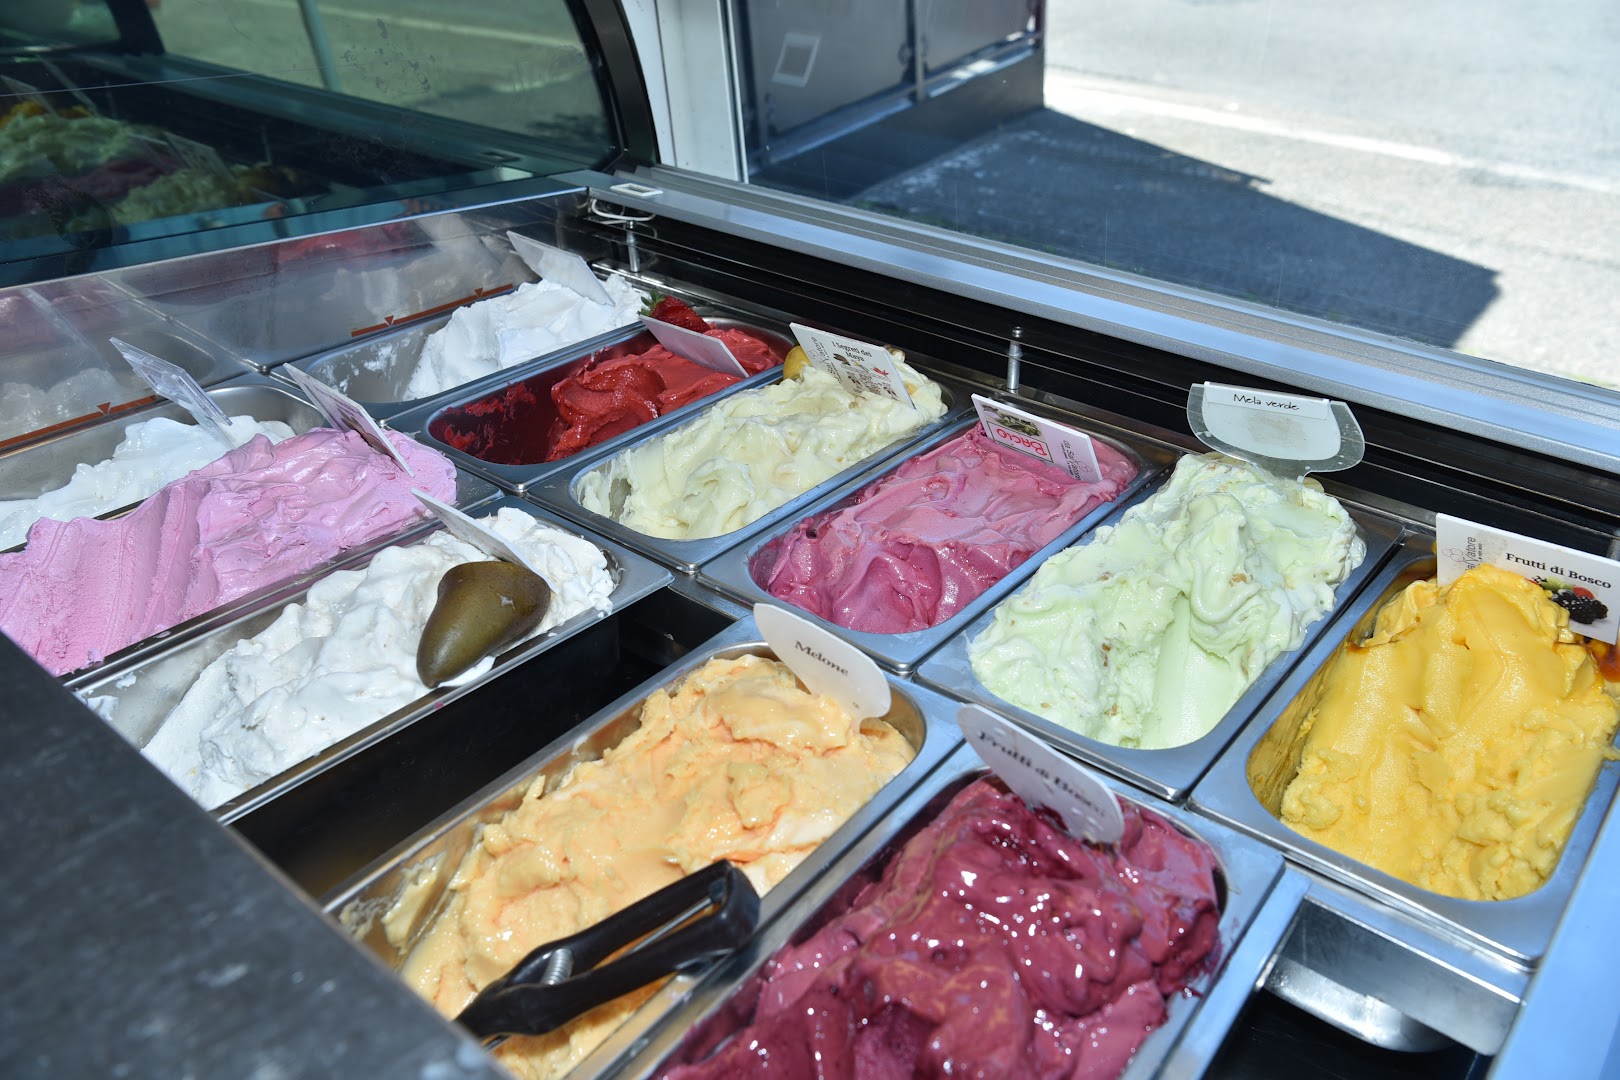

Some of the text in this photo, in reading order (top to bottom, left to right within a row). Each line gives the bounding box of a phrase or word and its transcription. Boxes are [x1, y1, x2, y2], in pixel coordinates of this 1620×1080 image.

[1233, 393, 1300, 411] Mela verde
[1505, 552, 1612, 589] Frutti di Bosco
[795, 640, 849, 677] Melone
